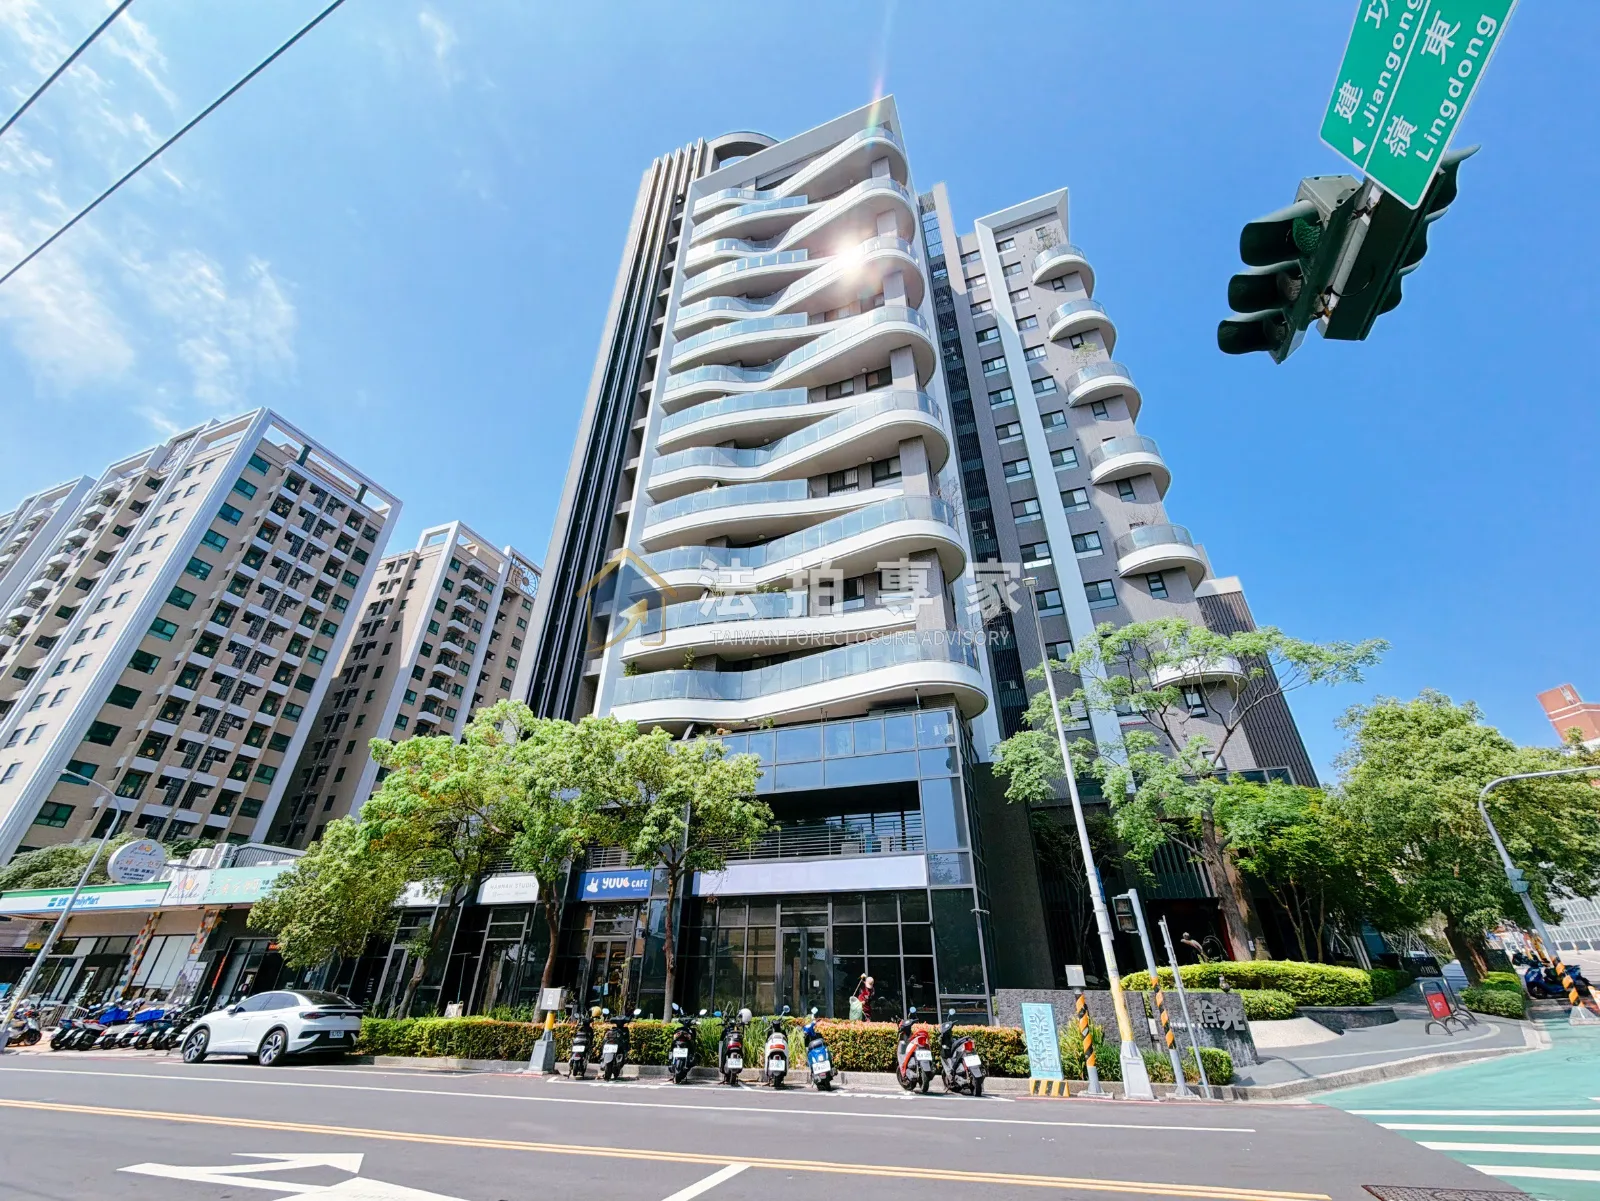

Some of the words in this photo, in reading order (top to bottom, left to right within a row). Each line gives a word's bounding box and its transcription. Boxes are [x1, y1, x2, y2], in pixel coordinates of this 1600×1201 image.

[1383, 10, 1462, 158] 嶺東
[1415, 14, 1498, 162] Lingdong
[631, 879, 648, 888] CAFE
